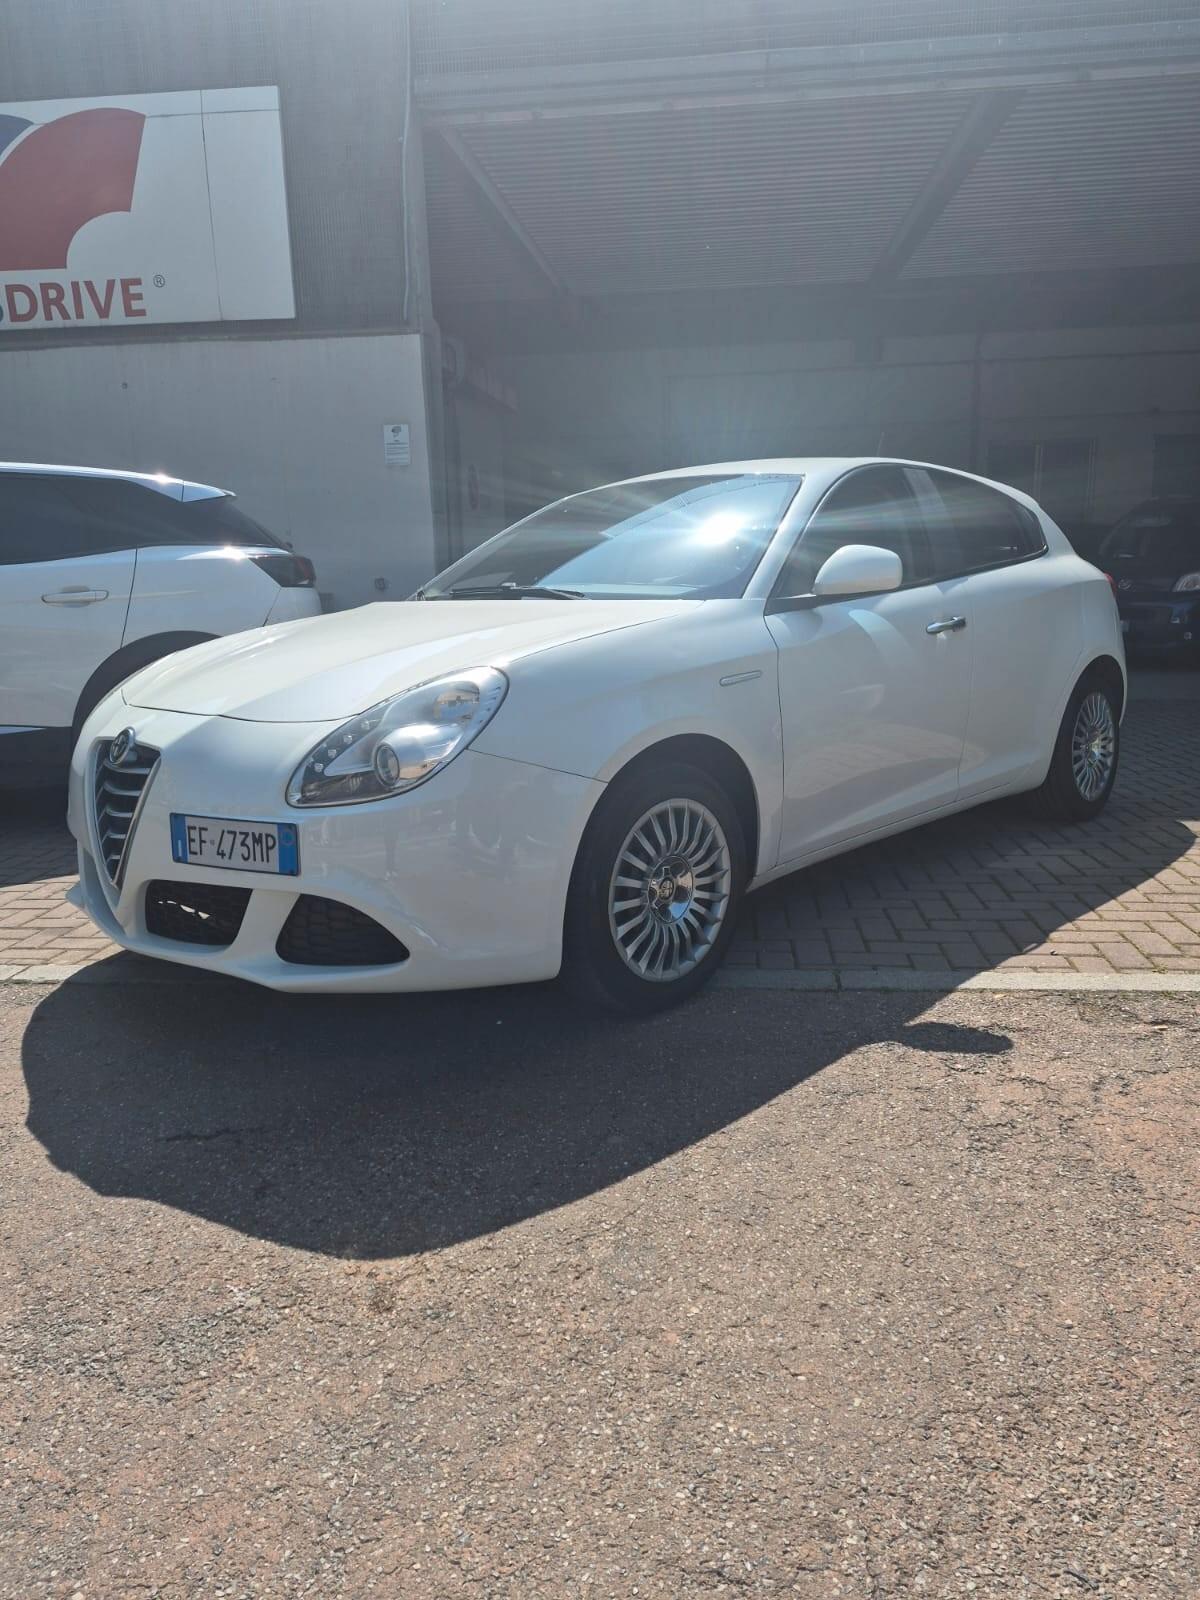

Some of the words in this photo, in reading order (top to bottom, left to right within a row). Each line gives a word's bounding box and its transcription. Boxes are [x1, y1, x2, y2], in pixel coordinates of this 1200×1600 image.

[0, 277, 147, 323] DRIVE
[187, 825, 208, 855] EF
[216, 829, 277, 863] 473MP
